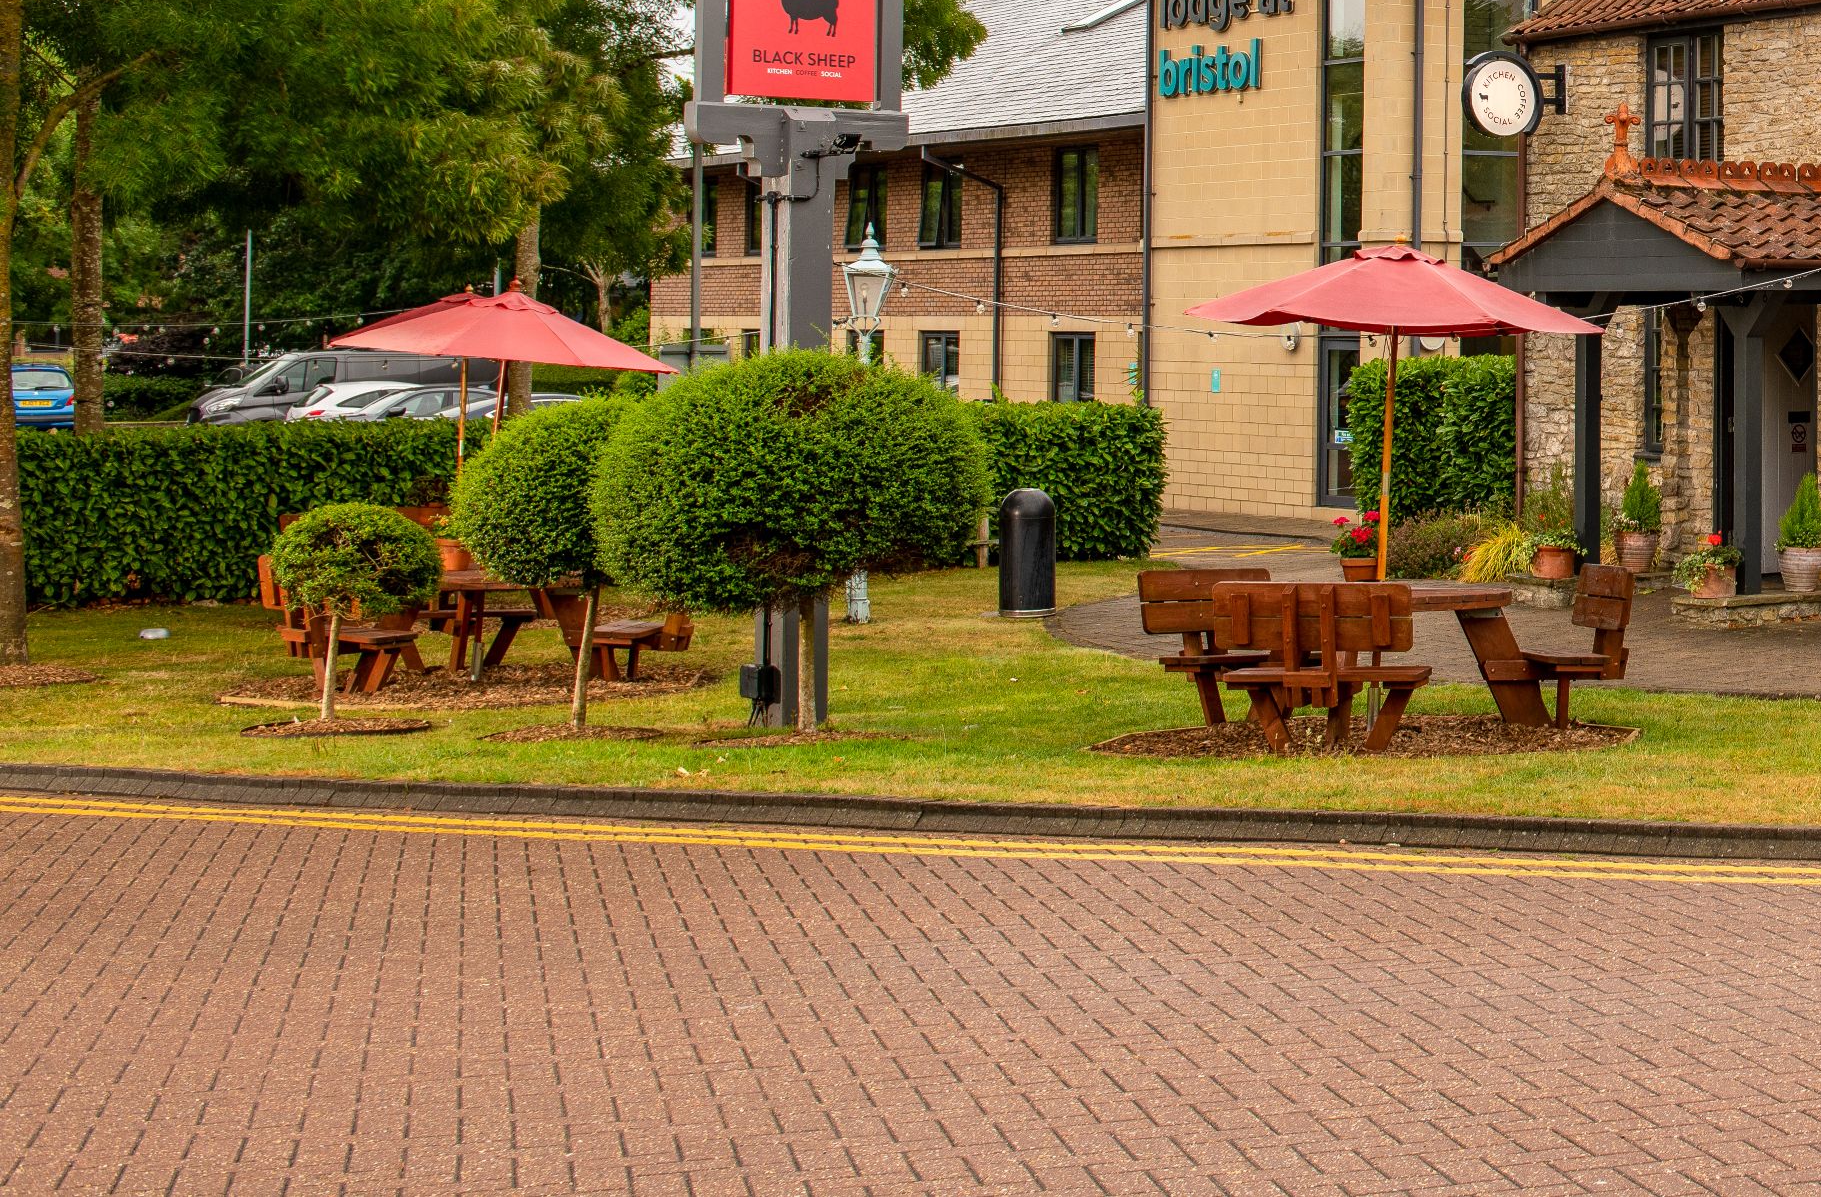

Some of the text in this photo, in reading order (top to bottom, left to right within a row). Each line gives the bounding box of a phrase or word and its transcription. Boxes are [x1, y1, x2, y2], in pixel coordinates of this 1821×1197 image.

[752, 49, 856, 68] BLACK SHEEP
[767, 67, 842, 78] KITCHEN COFFEE SOCIAL
[1159, 37, 1263, 98] bristol
[1482, 71, 1527, 126] KITCHEN COFFEE SOCIAL
